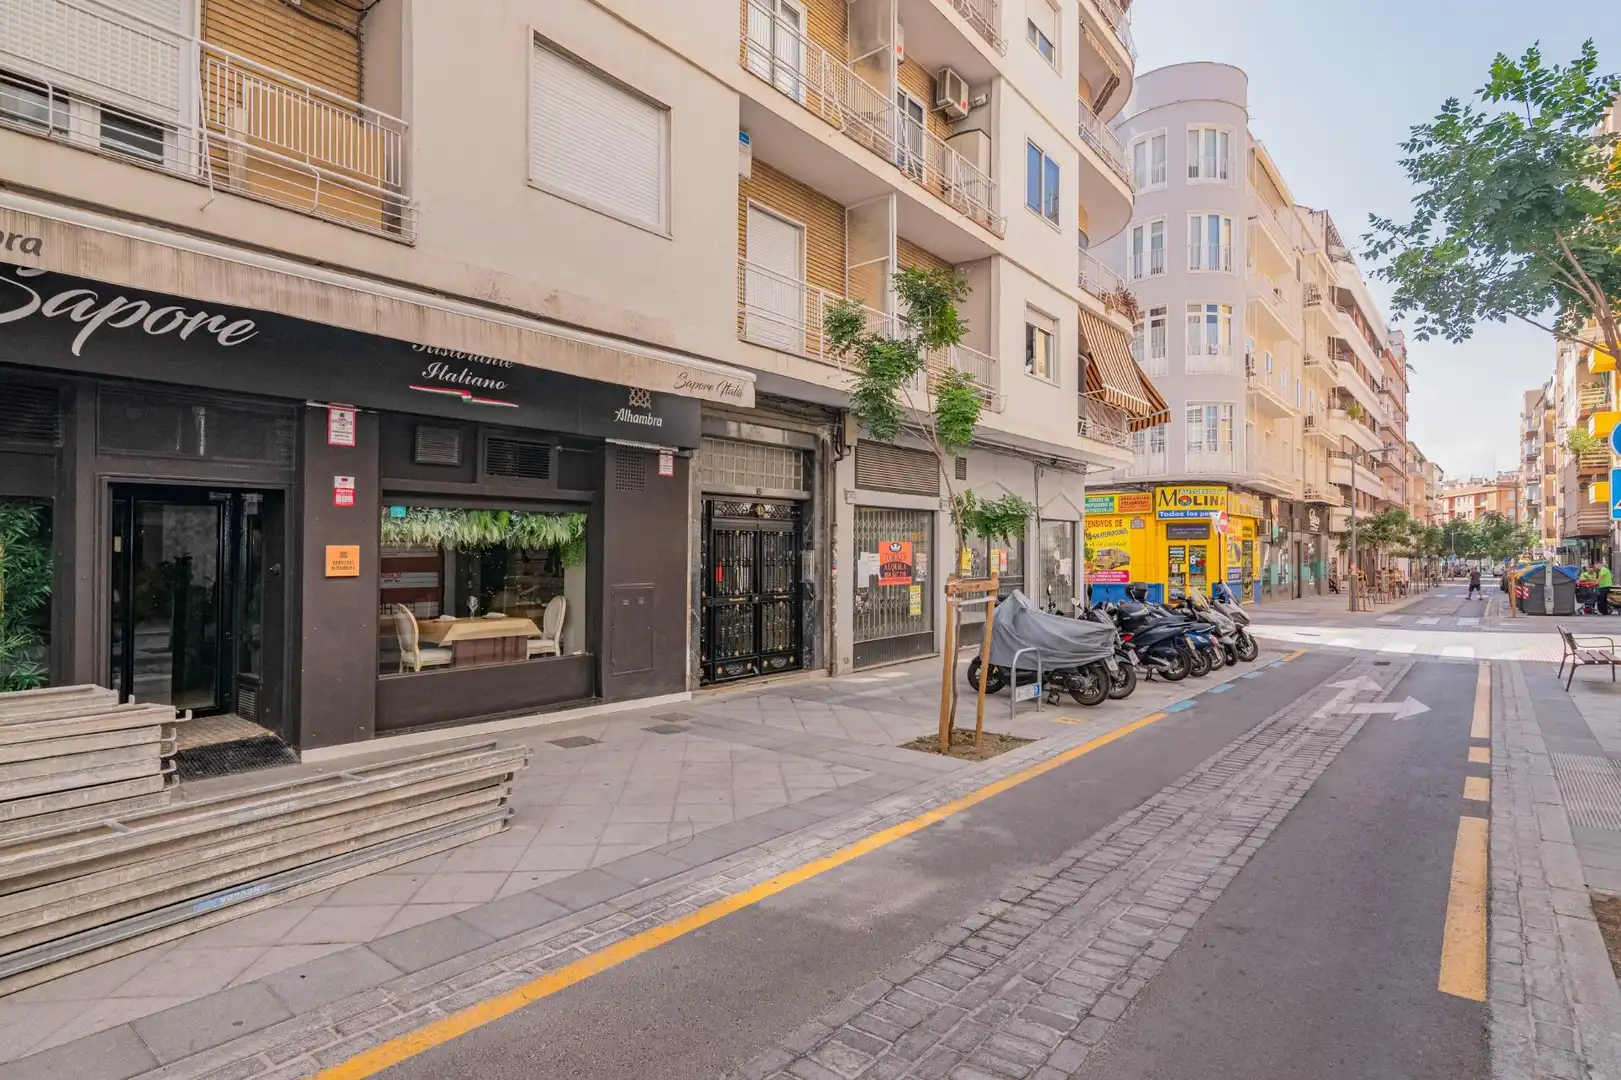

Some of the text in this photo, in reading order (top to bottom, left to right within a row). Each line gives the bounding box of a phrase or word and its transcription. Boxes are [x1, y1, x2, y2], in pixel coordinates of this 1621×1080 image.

[0, 230, 43, 256] ra
[421, 362, 508, 390] Italiano
[673, 371, 714, 393] Sapore
[613, 408, 663, 428] Alhambra
[1158, 488, 1226, 507] MOLINA
